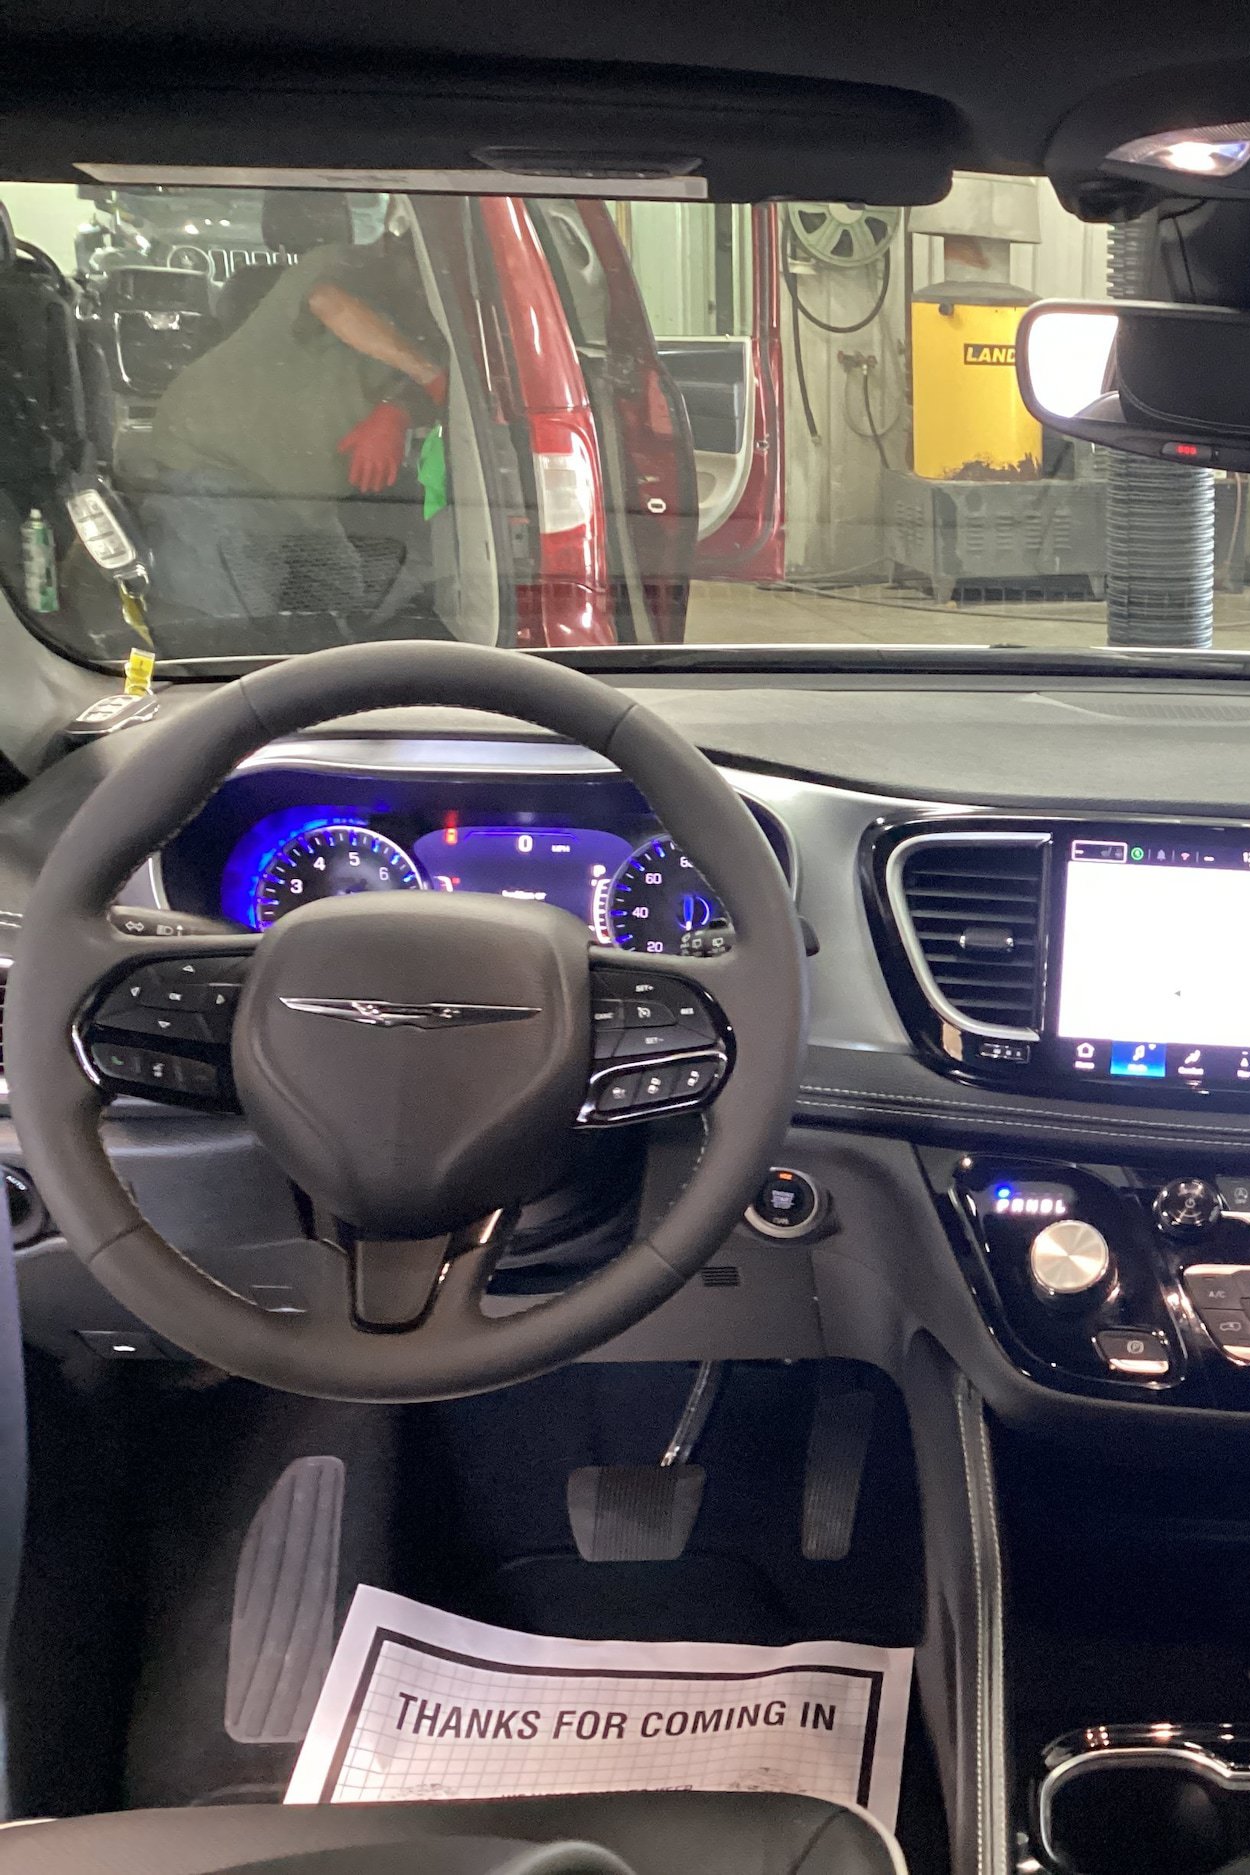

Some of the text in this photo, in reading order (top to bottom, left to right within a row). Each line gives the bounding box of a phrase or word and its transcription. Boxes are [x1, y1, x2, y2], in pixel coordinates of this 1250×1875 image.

[518, 834, 533, 852] 0
[313, 857, 326, 871] 4
[348, 852, 361, 866] 5
[378, 866, 389, 881] 6
[645, 873, 662, 885] 60
[290, 879, 303, 894] 3
[632, 907, 649, 918] 40
[647, 941, 663, 953] 20
[1208, 1290, 1226, 1299] A/C
[396, 1692, 836, 1740] THANKS FOR COMING IN
